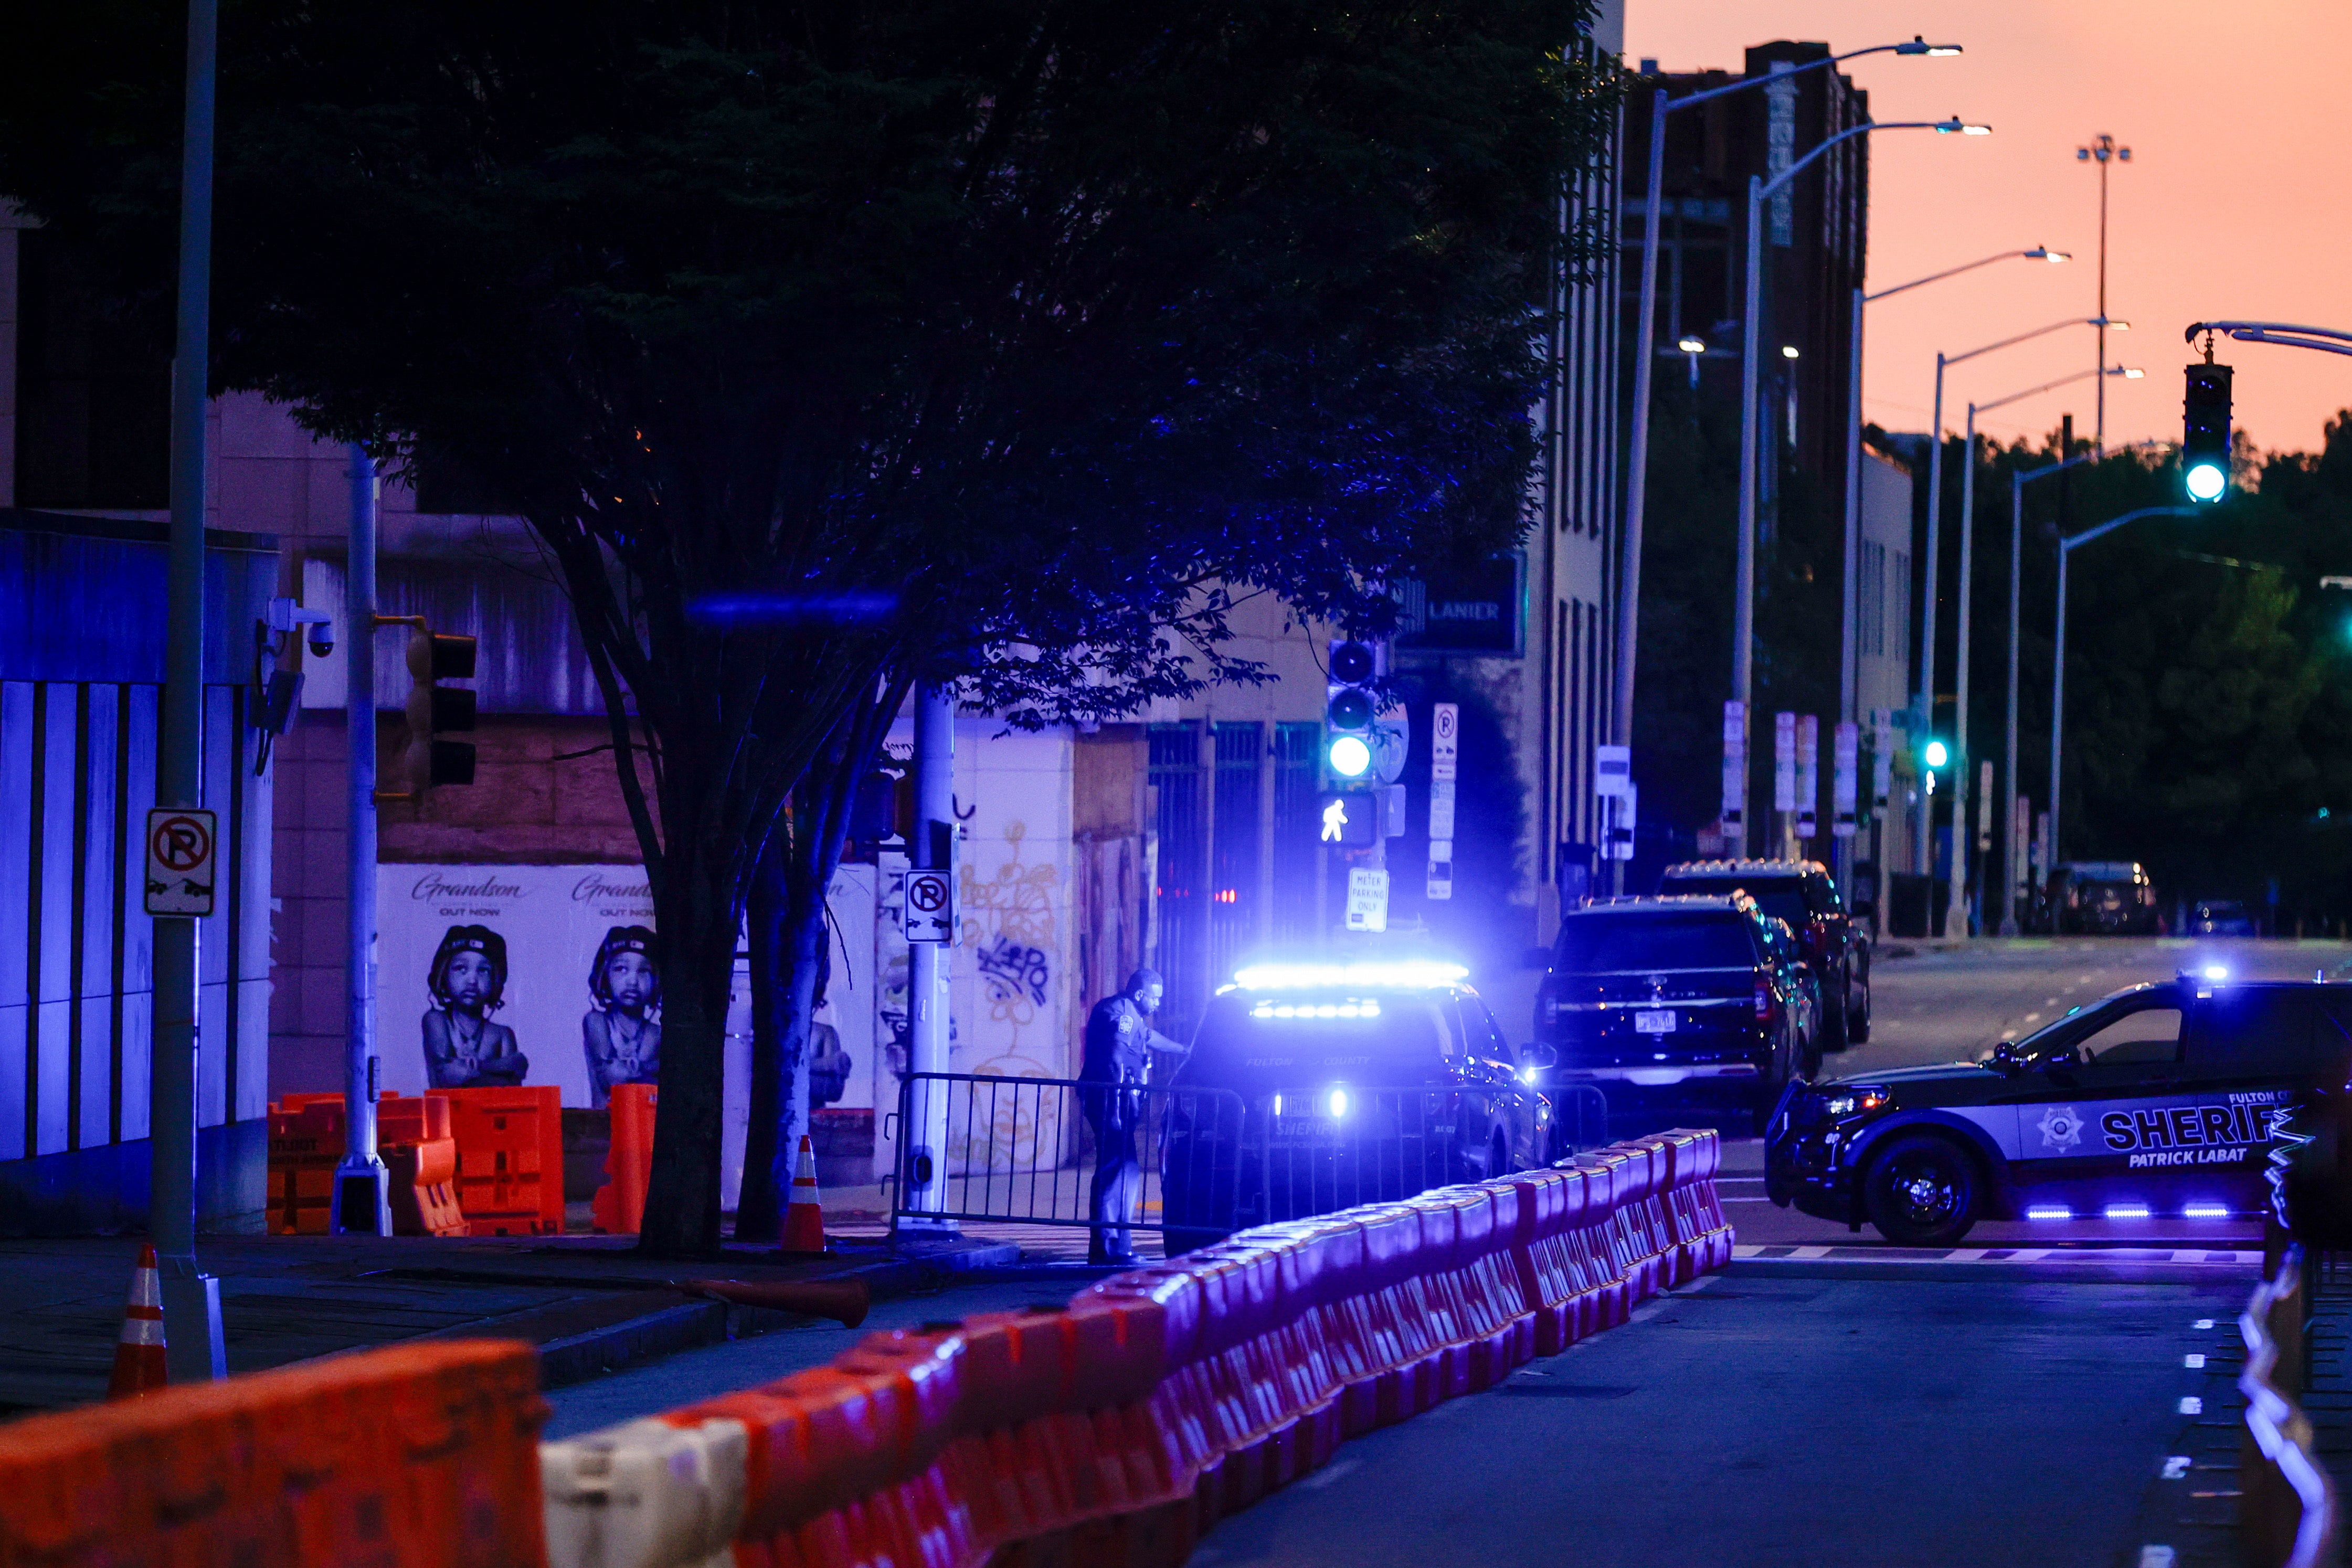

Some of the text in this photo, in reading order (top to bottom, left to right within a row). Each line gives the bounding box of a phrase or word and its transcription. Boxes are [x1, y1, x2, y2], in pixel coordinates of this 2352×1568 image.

[1357, 876, 1381, 886] METER
[411, 872, 528, 905] Grandson
[571, 872, 652, 906] Grand
[1352, 888, 1384, 899] PARKING
[1358, 900, 1378, 912] ONLY
[439, 908, 500, 917] OUT NOW
[599, 908, 627, 917] OUT
[1246, 1056, 1371, 1067] FULTON COUNTY
[2228, 1092, 2274, 1104] FULTON
[2100, 1103, 2279, 1152] SHERIF
[2128, 1148, 2248, 1168] PATRICK LABAT
